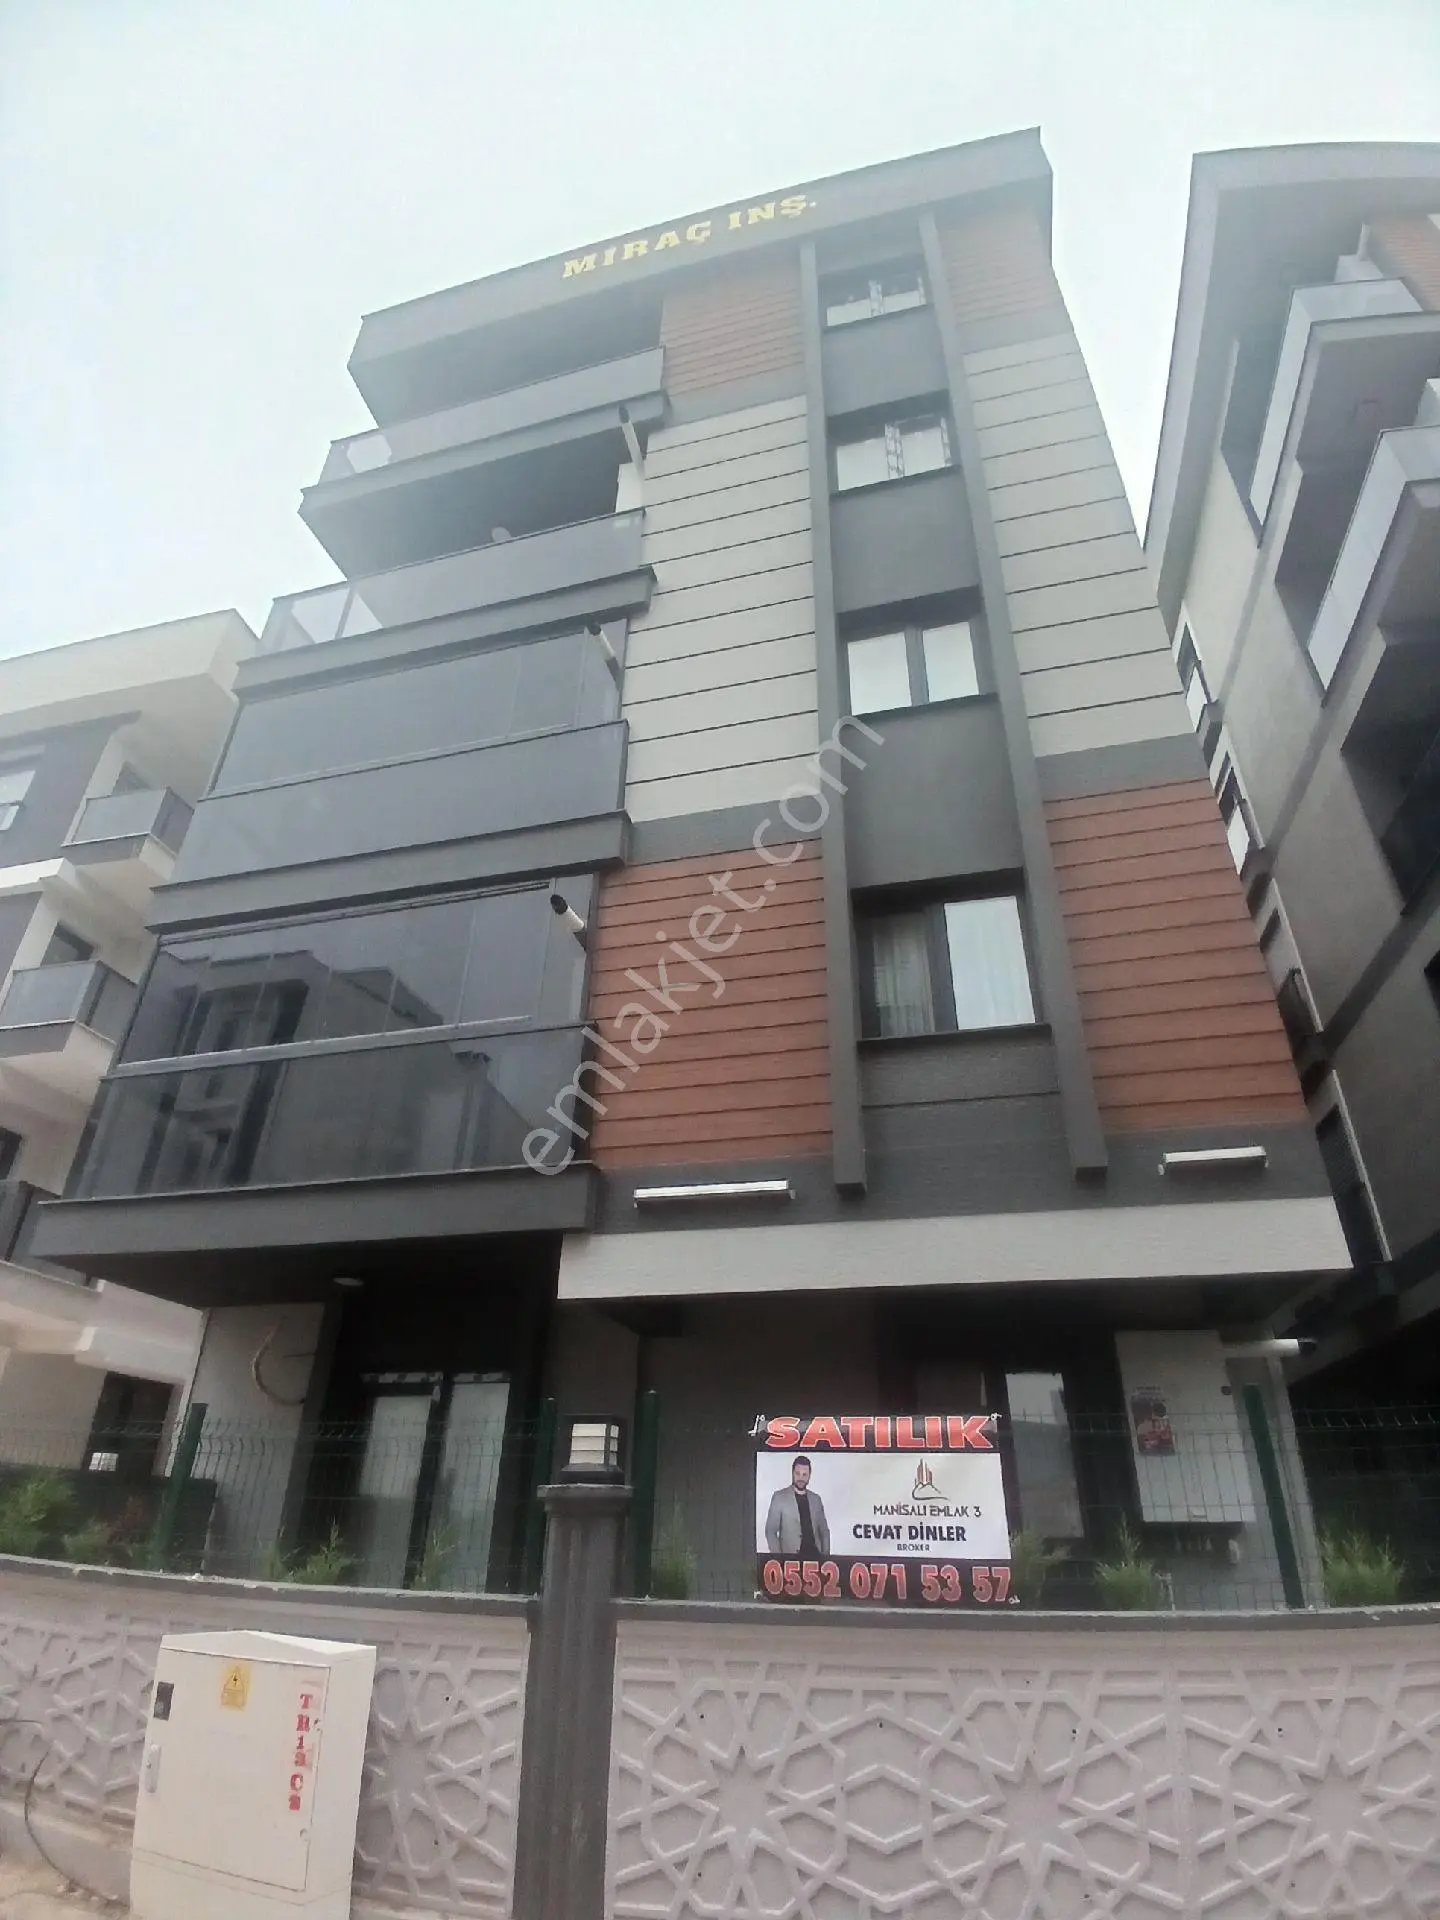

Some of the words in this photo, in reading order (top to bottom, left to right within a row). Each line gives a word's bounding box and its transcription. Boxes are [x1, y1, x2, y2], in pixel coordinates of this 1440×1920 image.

[765, 1415, 993, 1449] SATILIK
[873, 1501, 927, 1517] MANİSALI
[929, 1505, 970, 1517] EMLAK
[973, 1505, 982, 1518] 3
[852, 1523, 903, 1540] CEVAT
[908, 1521, 967, 1542] DİNLER
[896, 1543, 930, 1552] BROKER
[763, 1560, 841, 1598] 0552
[850, 1562, 907, 1600] 071
[921, 1564, 962, 1602] 53
[972, 1566, 1011, 1603] 57
